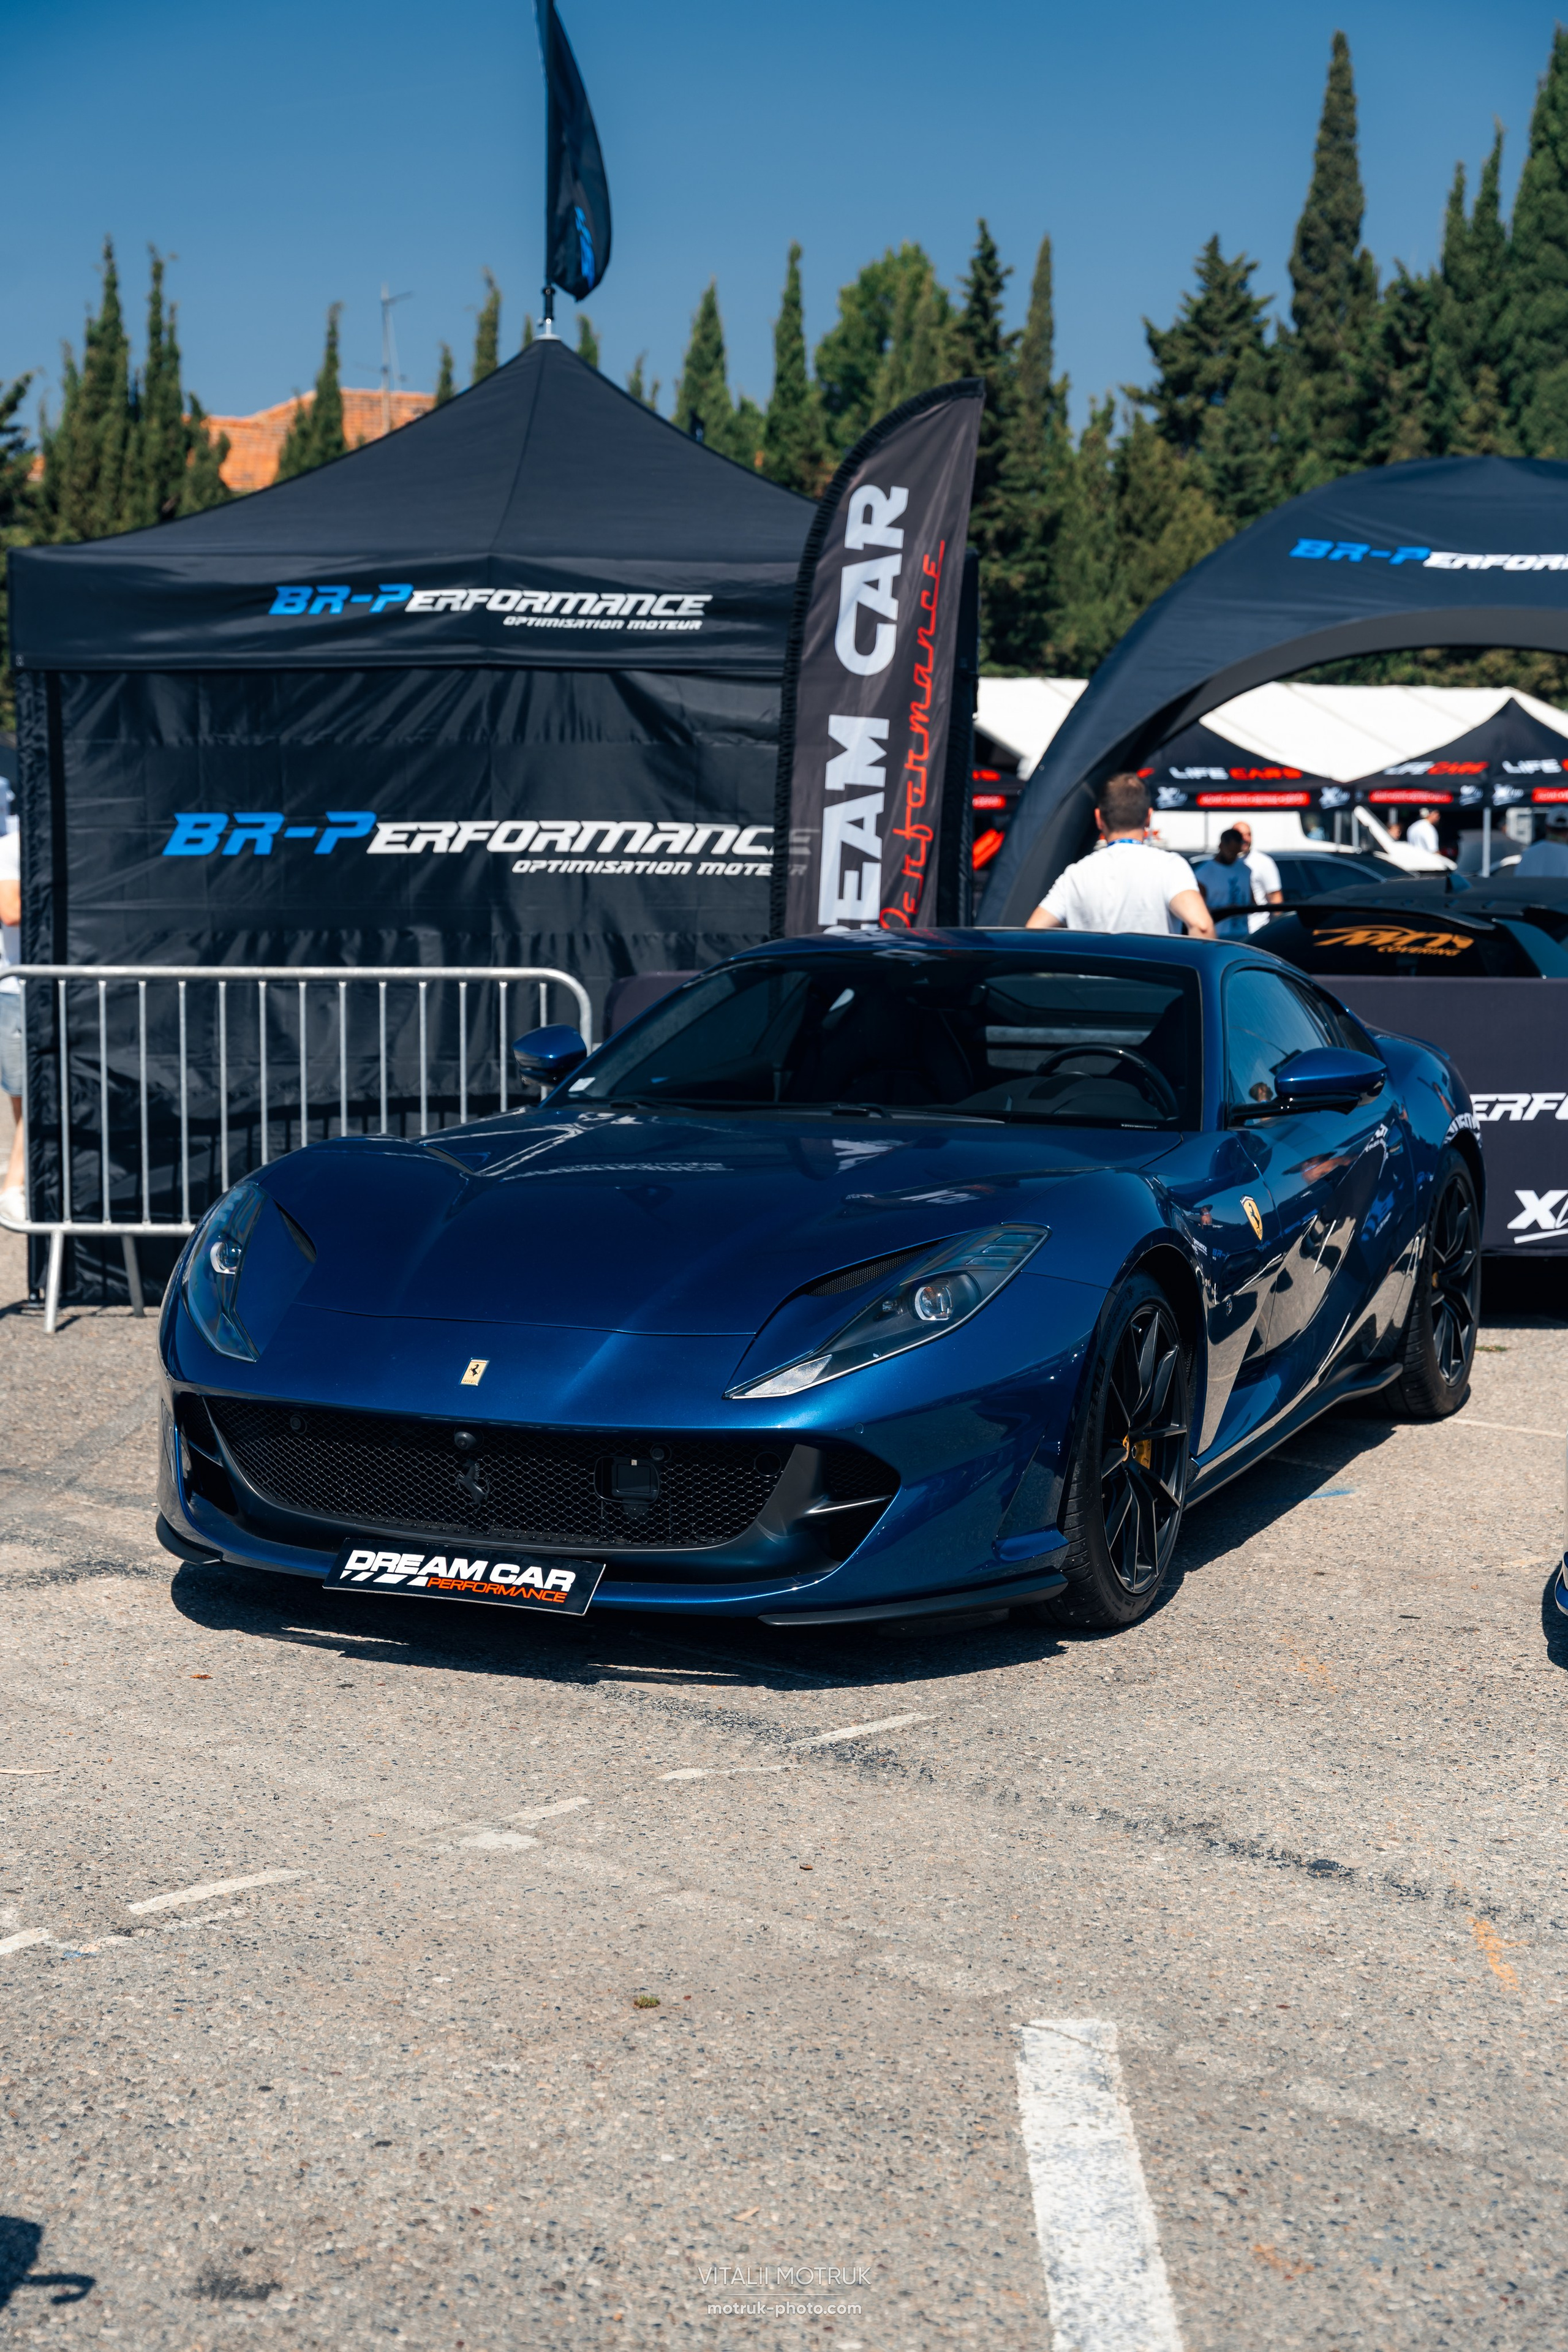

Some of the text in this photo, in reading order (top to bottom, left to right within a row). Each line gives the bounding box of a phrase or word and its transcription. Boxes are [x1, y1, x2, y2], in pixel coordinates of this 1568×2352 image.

[1289, 538, 1568, 571] BR-PERFOR
[268, 583, 713, 616] BR-PERFORMANCE
[502, 616, 703, 631] OPTIMISATION MOTEUR
[818, 484, 909, 931] EAM CAR
[512, 859, 691, 875] OPTIMISATION
[344, 1550, 576, 1593] DREAM CAR
[427, 1577, 568, 1604] PERFORMANCE
